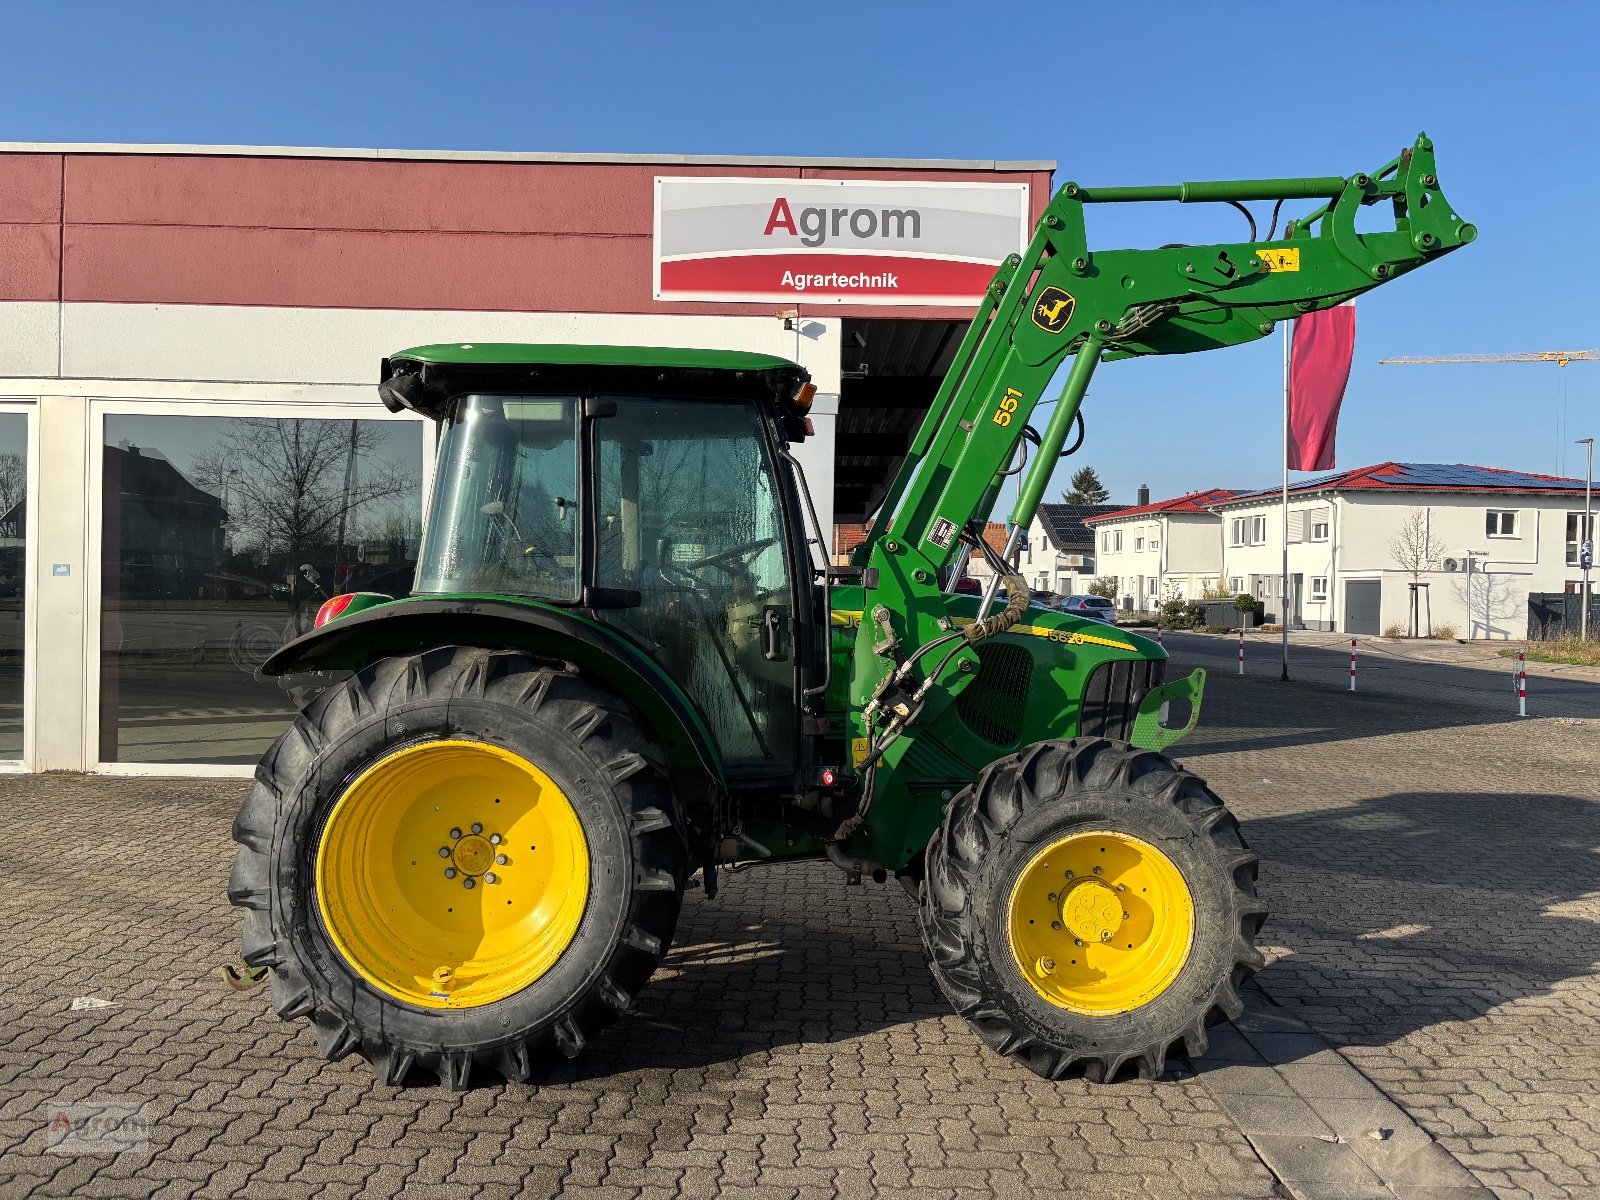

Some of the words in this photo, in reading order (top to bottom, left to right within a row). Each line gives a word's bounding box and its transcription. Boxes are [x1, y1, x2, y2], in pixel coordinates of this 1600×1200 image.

[764, 198, 920, 247] Agrom
[781, 271, 898, 290] Agrartechnik
[993, 386, 1024, 427] 551
[1048, 630, 1083, 645] 5620
